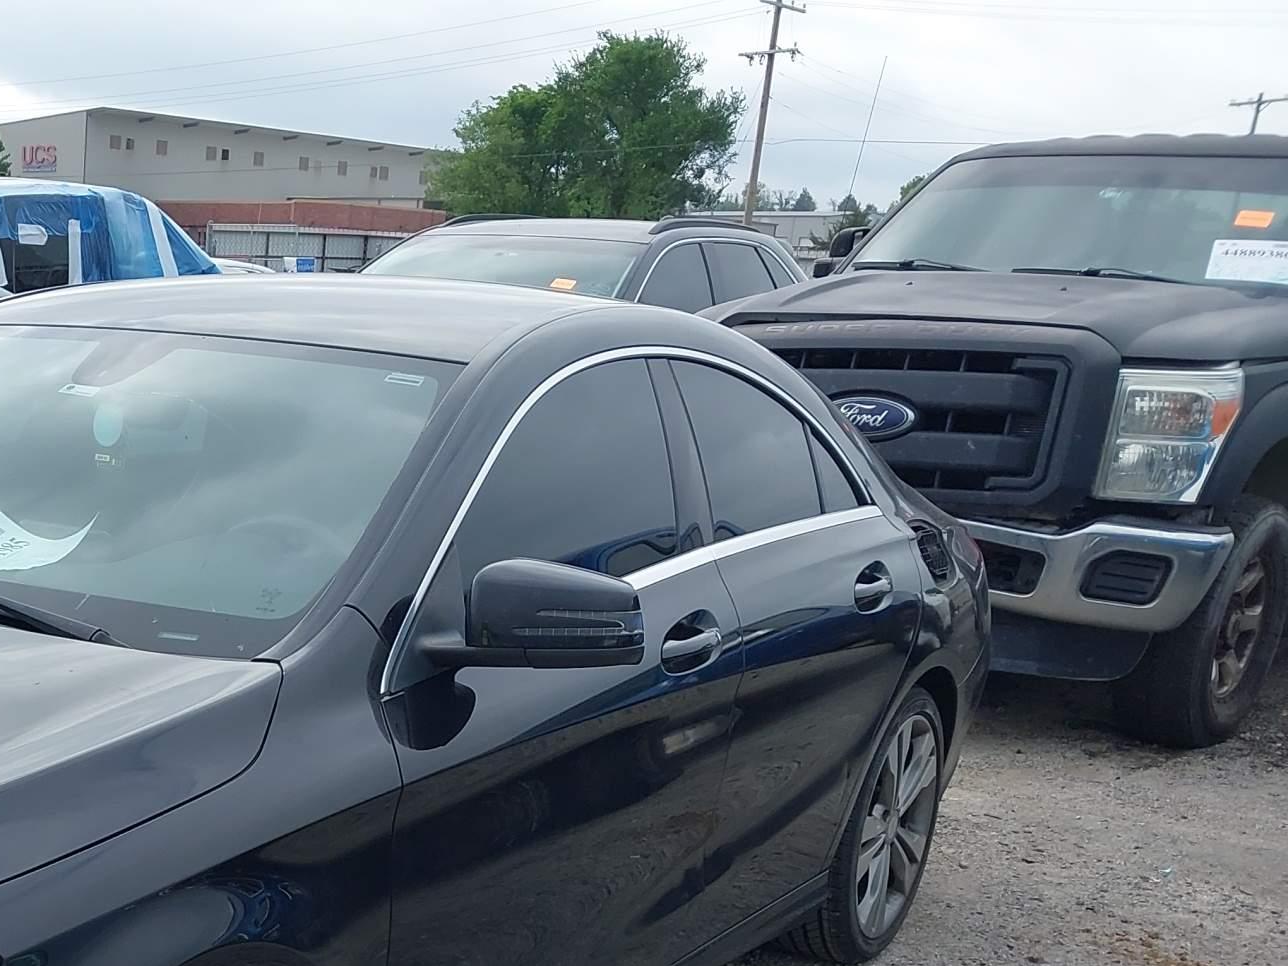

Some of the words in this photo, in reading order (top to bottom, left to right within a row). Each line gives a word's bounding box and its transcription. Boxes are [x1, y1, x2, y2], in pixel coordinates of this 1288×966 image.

[22, 145, 57, 166] UCS
[764, 322, 894, 337] SUPER
[840, 402, 889, 427] Ford
